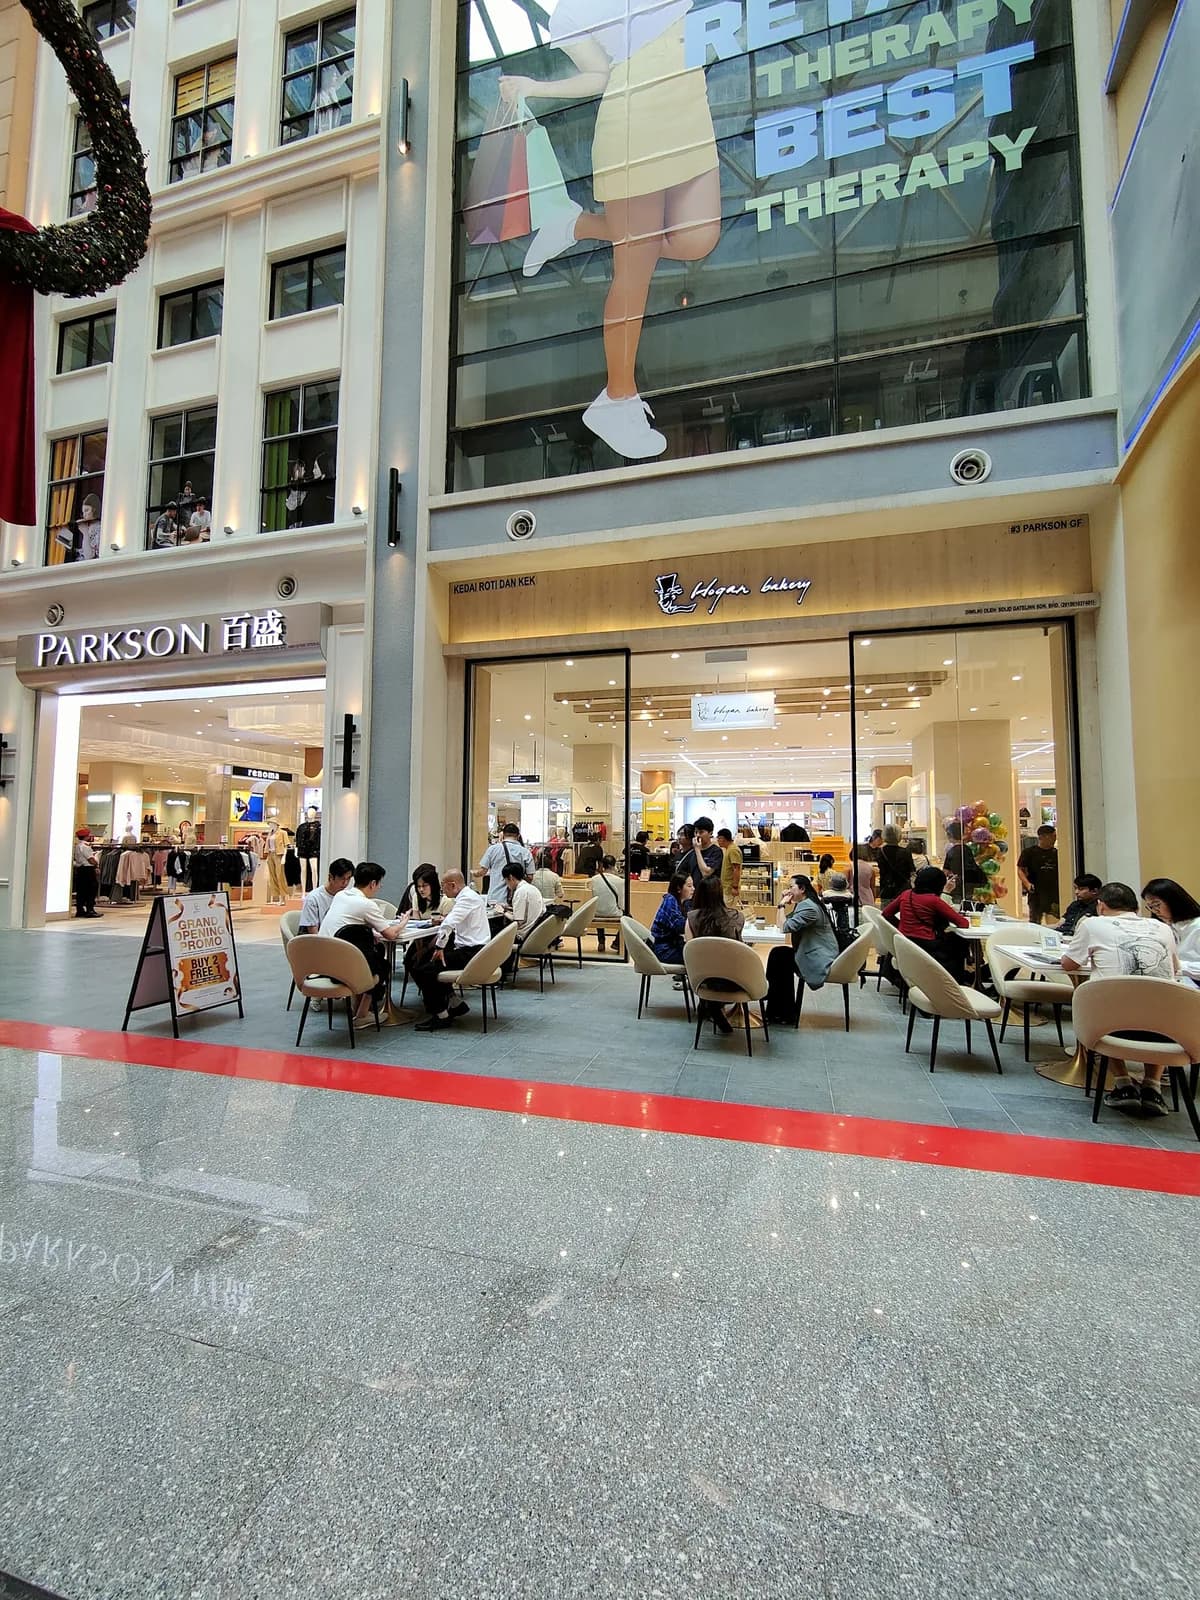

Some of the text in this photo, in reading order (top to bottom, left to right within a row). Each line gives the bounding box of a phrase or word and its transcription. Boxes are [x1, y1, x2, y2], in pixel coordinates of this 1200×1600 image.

[756, 0, 1034, 98] THERAPY
[755, 41, 1035, 179] BEST
[745, 126, 1038, 233] THERAPY
[1010, 518, 1083, 535] #3 PARKSON GF
[453, 575, 536, 594] KEDAI ROTI DAN KEK
[690, 576, 812, 614] Hogan bakery
[36, 609, 286, 667] PARKSON 百盛
[247, 768, 280, 780] renoma
[178, 916, 218, 930] GRAND
[173, 926, 225, 941] OPENING
[179, 937, 222, 951] PROMO
[191, 955, 219, 969] BUY 2
[189, 966, 214, 980] FREE
